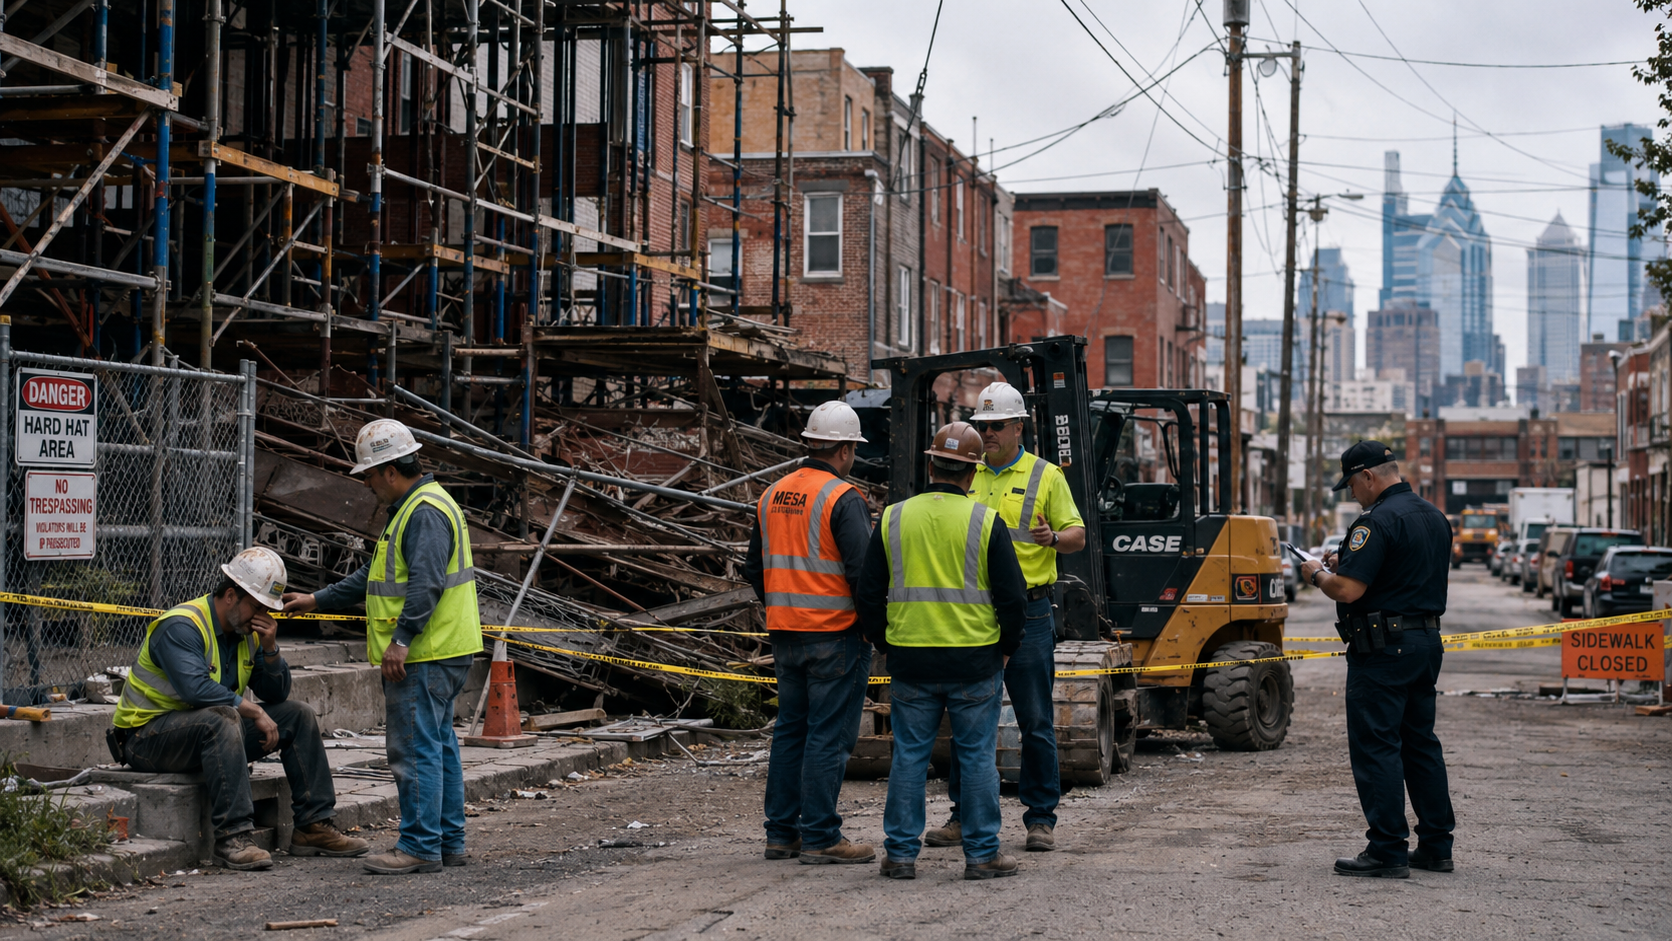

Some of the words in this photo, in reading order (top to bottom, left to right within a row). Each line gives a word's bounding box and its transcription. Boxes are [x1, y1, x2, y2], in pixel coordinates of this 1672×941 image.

[29, 381, 86, 407] DANGER
[24, 415, 61, 435] HARD
[65, 419, 90, 437] HAT
[39, 439, 75, 458] AREA
[55, 479, 68, 494] NO
[30, 498, 93, 514] TRESPASSING
[772, 491, 807, 507] MESA
[1112, 535, 1182, 552] CASE
[1571, 632, 1655, 649] SIDEWALK
[1577, 655, 1648, 672] CLOSED
